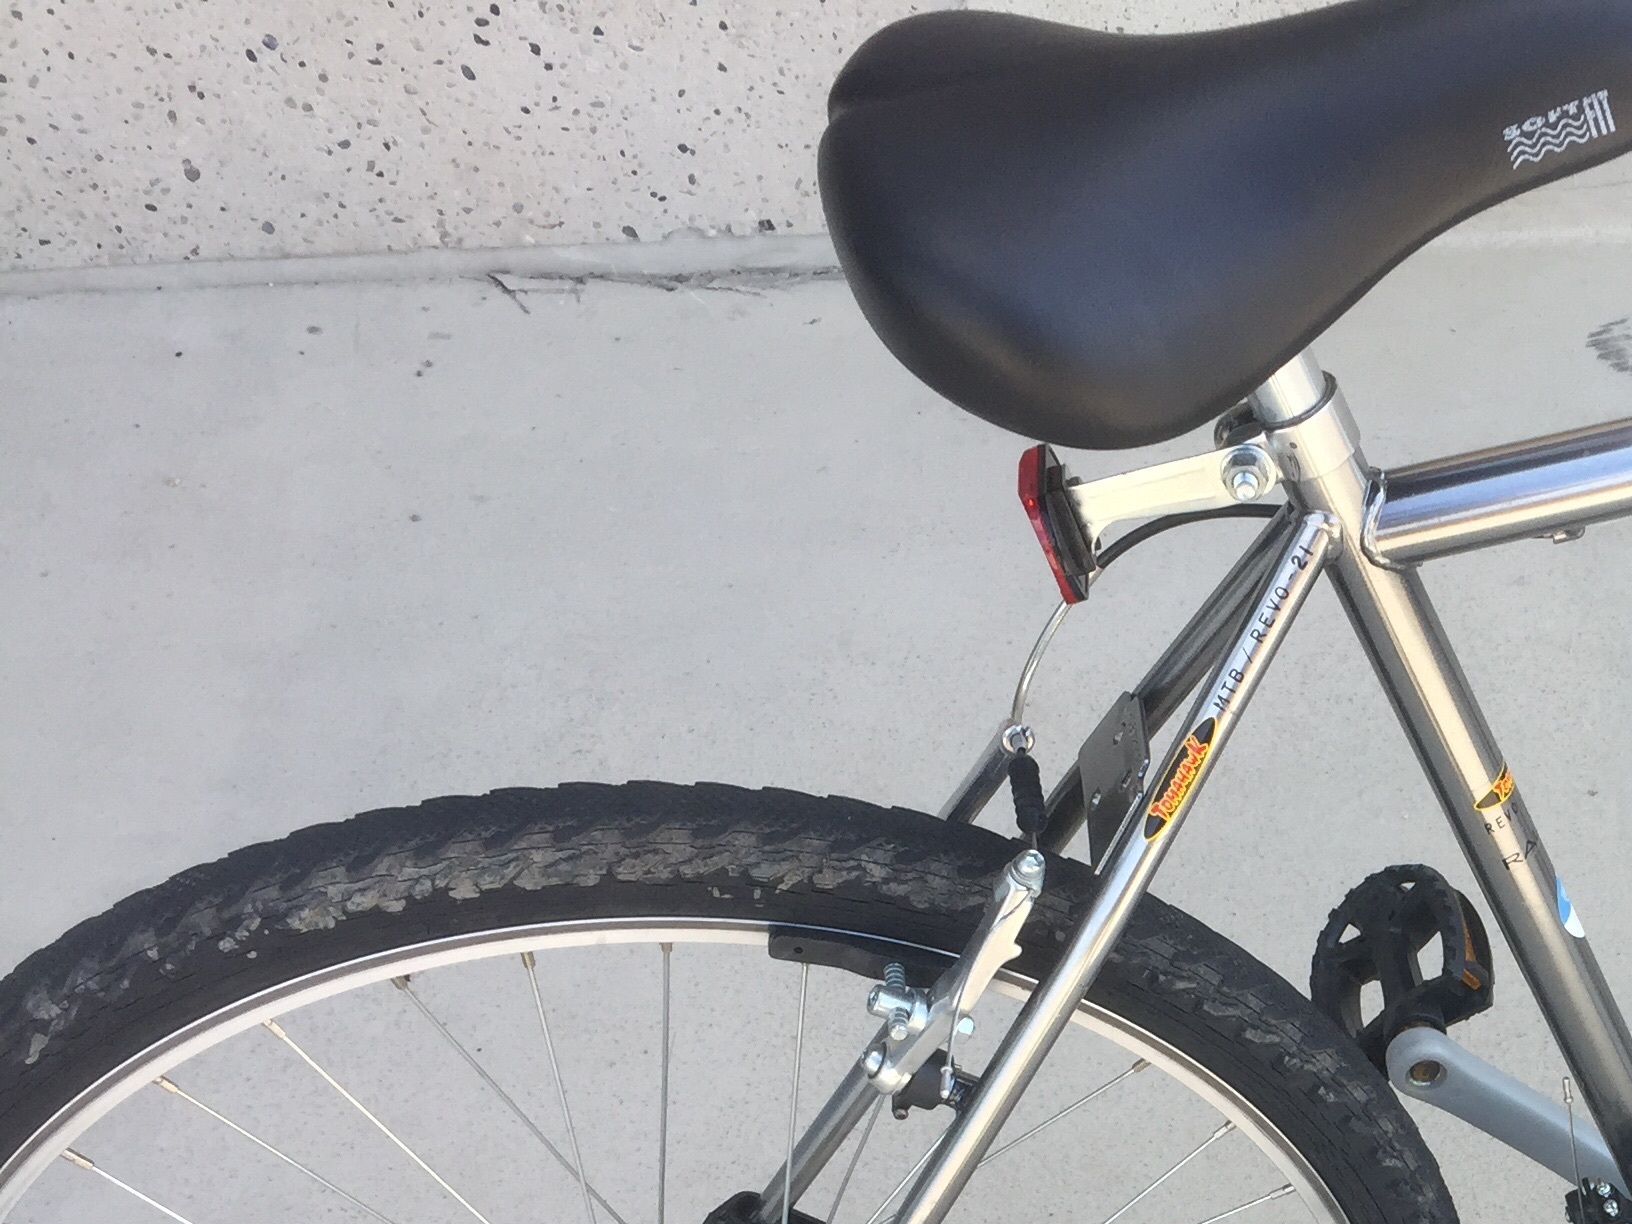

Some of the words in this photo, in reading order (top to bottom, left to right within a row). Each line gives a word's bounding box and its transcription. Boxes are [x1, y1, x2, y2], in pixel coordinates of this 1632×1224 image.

[1502, 99, 1581, 142] SOFT
[1582, 88, 1617, 139] FIT
[1213, 667, 1246, 713] MTB
[1249, 585, 1290, 645] REVO
[1150, 734, 1209, 822] TOMAHAWK
